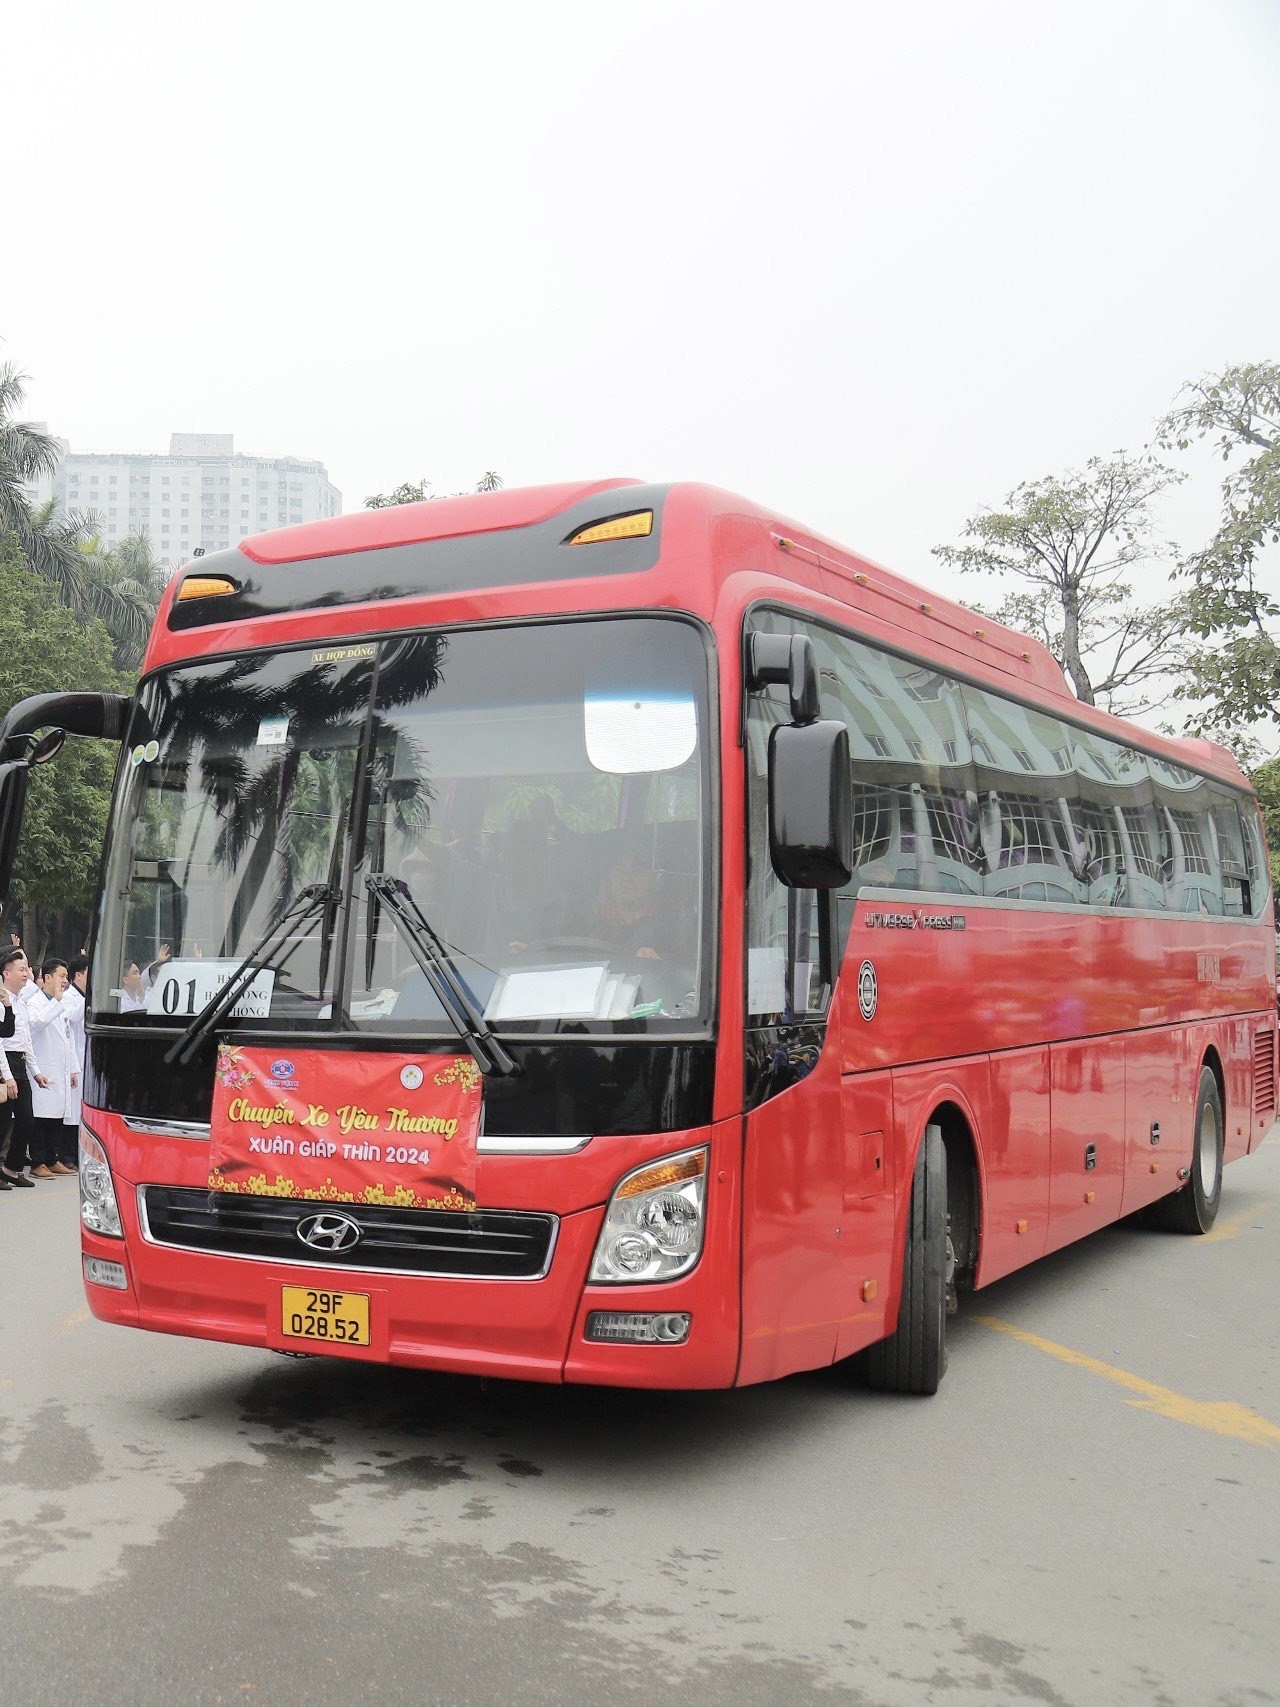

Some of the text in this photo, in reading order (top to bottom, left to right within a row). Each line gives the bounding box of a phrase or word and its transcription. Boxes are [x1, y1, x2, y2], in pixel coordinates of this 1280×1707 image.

[314, 653, 325, 662] XE
[162, 978, 198, 1015] 01
[229, 1004, 265, 1017] HÒNG
[227, 1098, 460, 1141] Chuyến Xe Yêu Thương
[248, 1135, 431, 1165] XUÂN GIÁP THÌN 2024
[306, 1291, 344, 1315] 29F
[291, 1313, 360, 1342] 028.52
